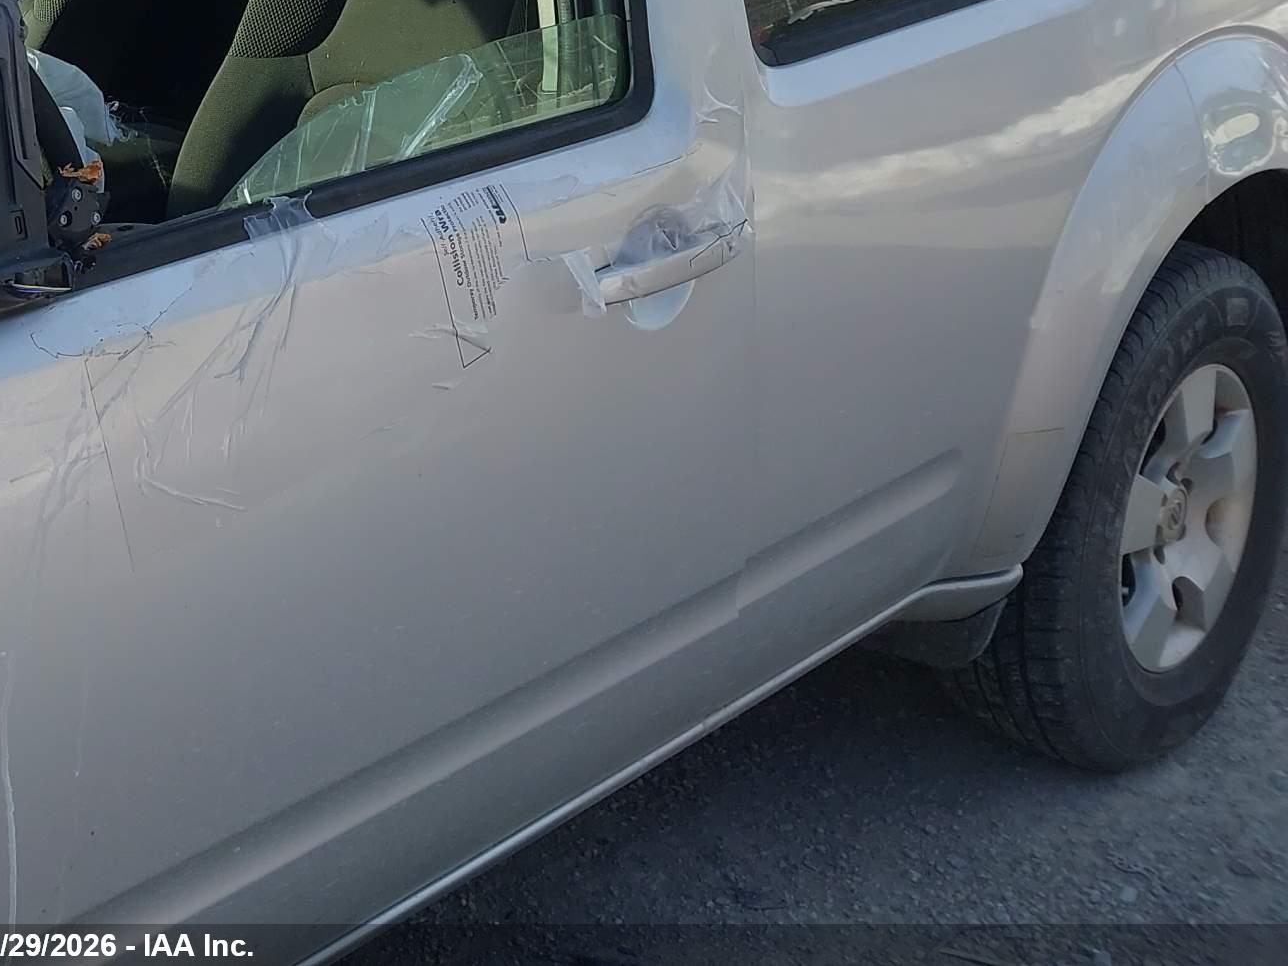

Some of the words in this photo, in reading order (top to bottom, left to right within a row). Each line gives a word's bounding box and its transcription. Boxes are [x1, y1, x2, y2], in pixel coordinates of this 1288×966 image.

[434, 209, 450, 233] Wra
[440, 204, 457, 232] Protectio
[456, 232, 465, 260] Storage
[448, 234, 464, 287] Collision
